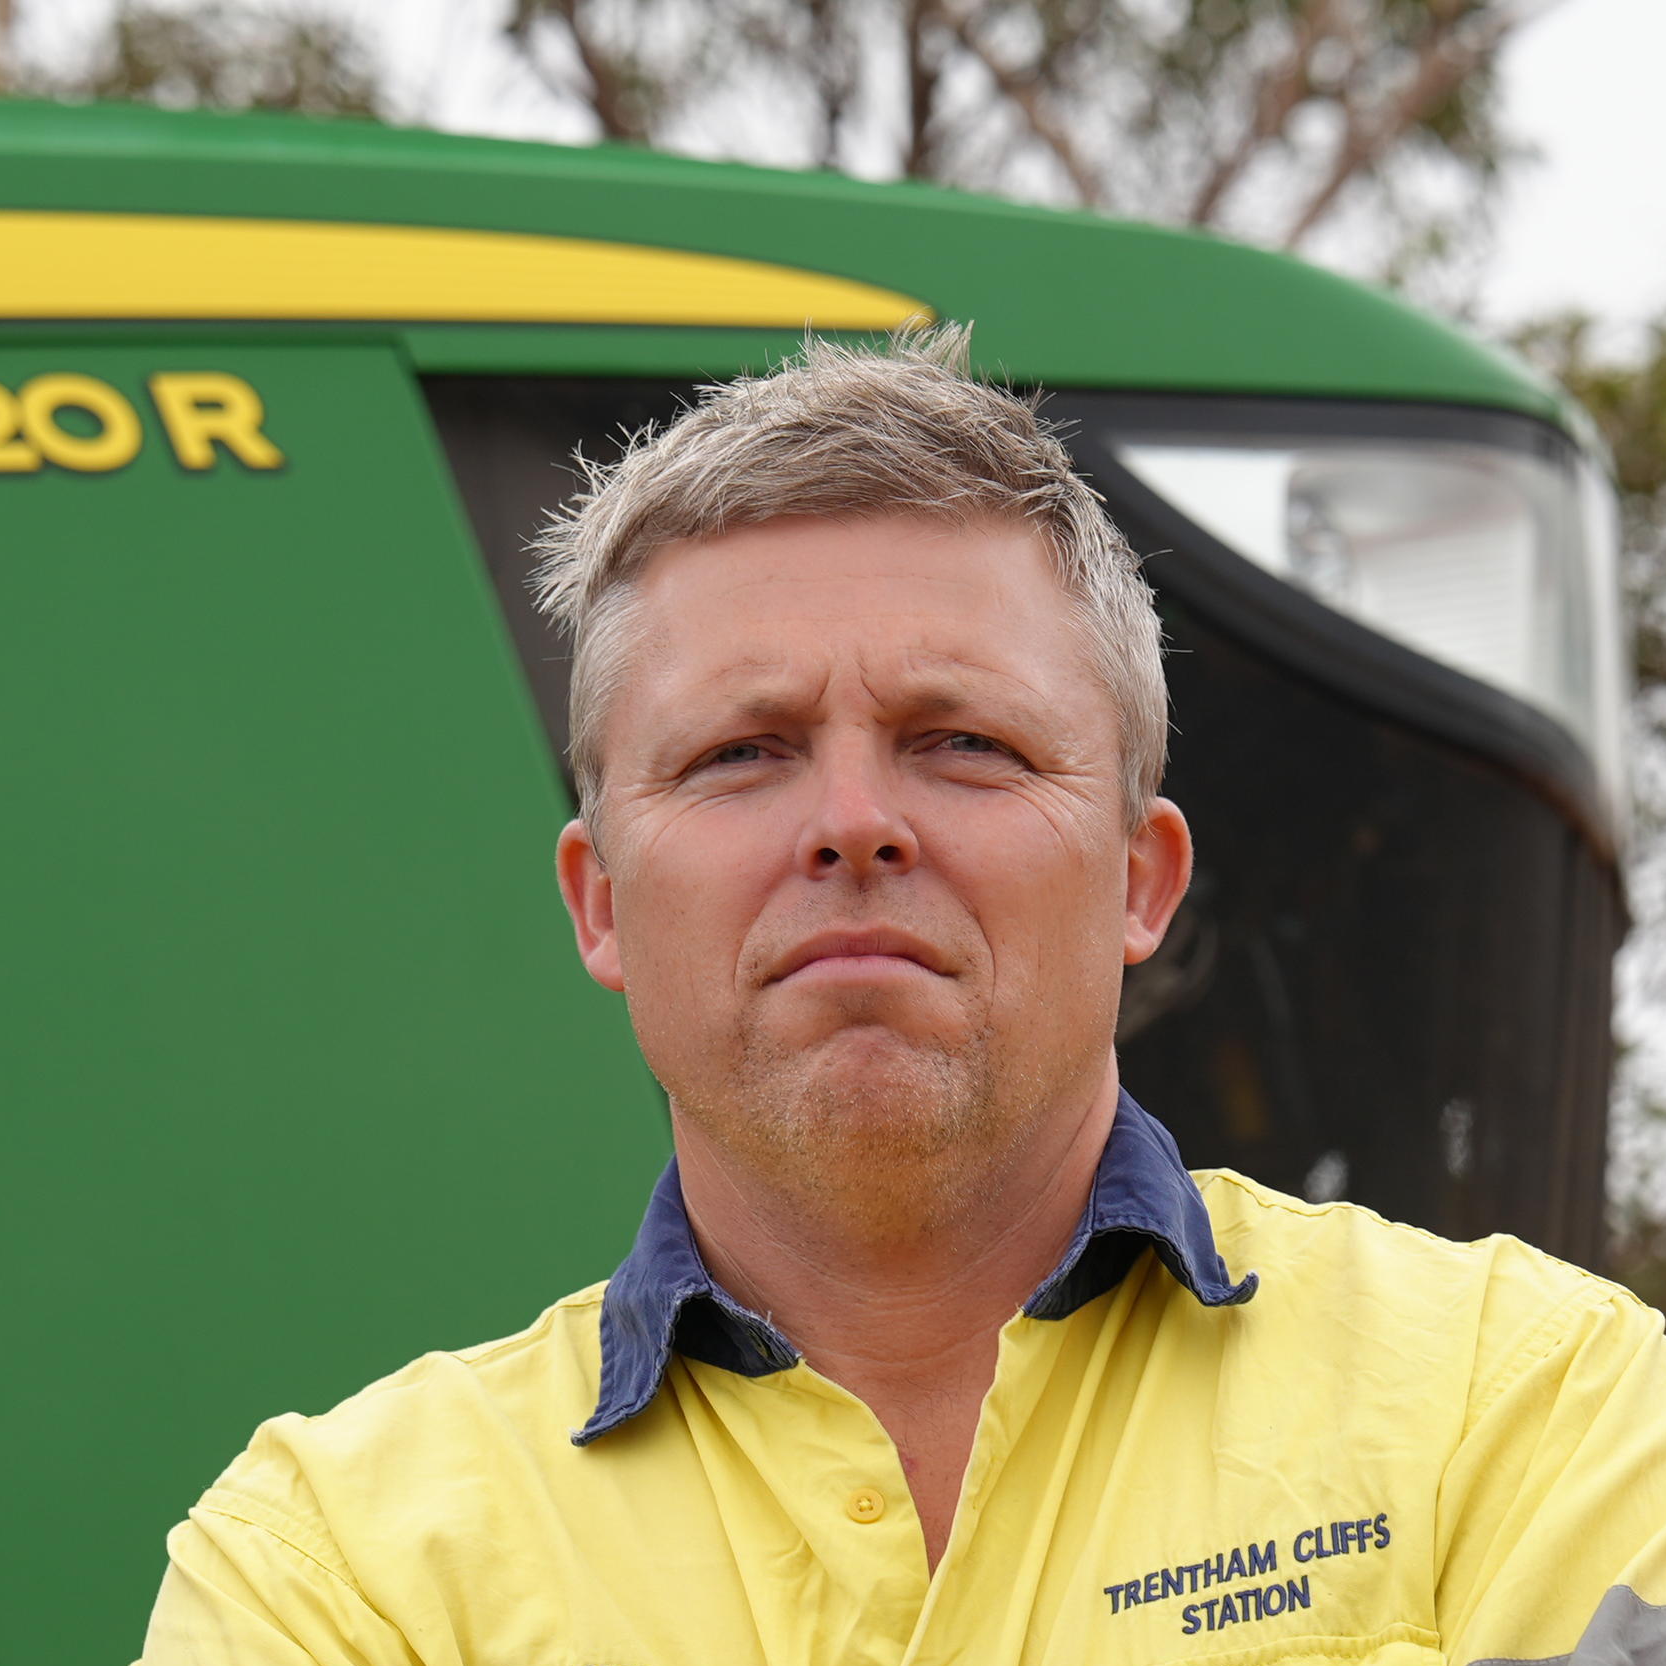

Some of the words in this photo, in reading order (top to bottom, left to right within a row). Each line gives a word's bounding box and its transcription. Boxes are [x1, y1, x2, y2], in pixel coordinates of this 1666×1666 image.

[1103, 1540, 1277, 1615] TRENTHAM
[1293, 1512, 1391, 1563] CLIFFS
[1181, 1575, 1311, 1635] STATION
